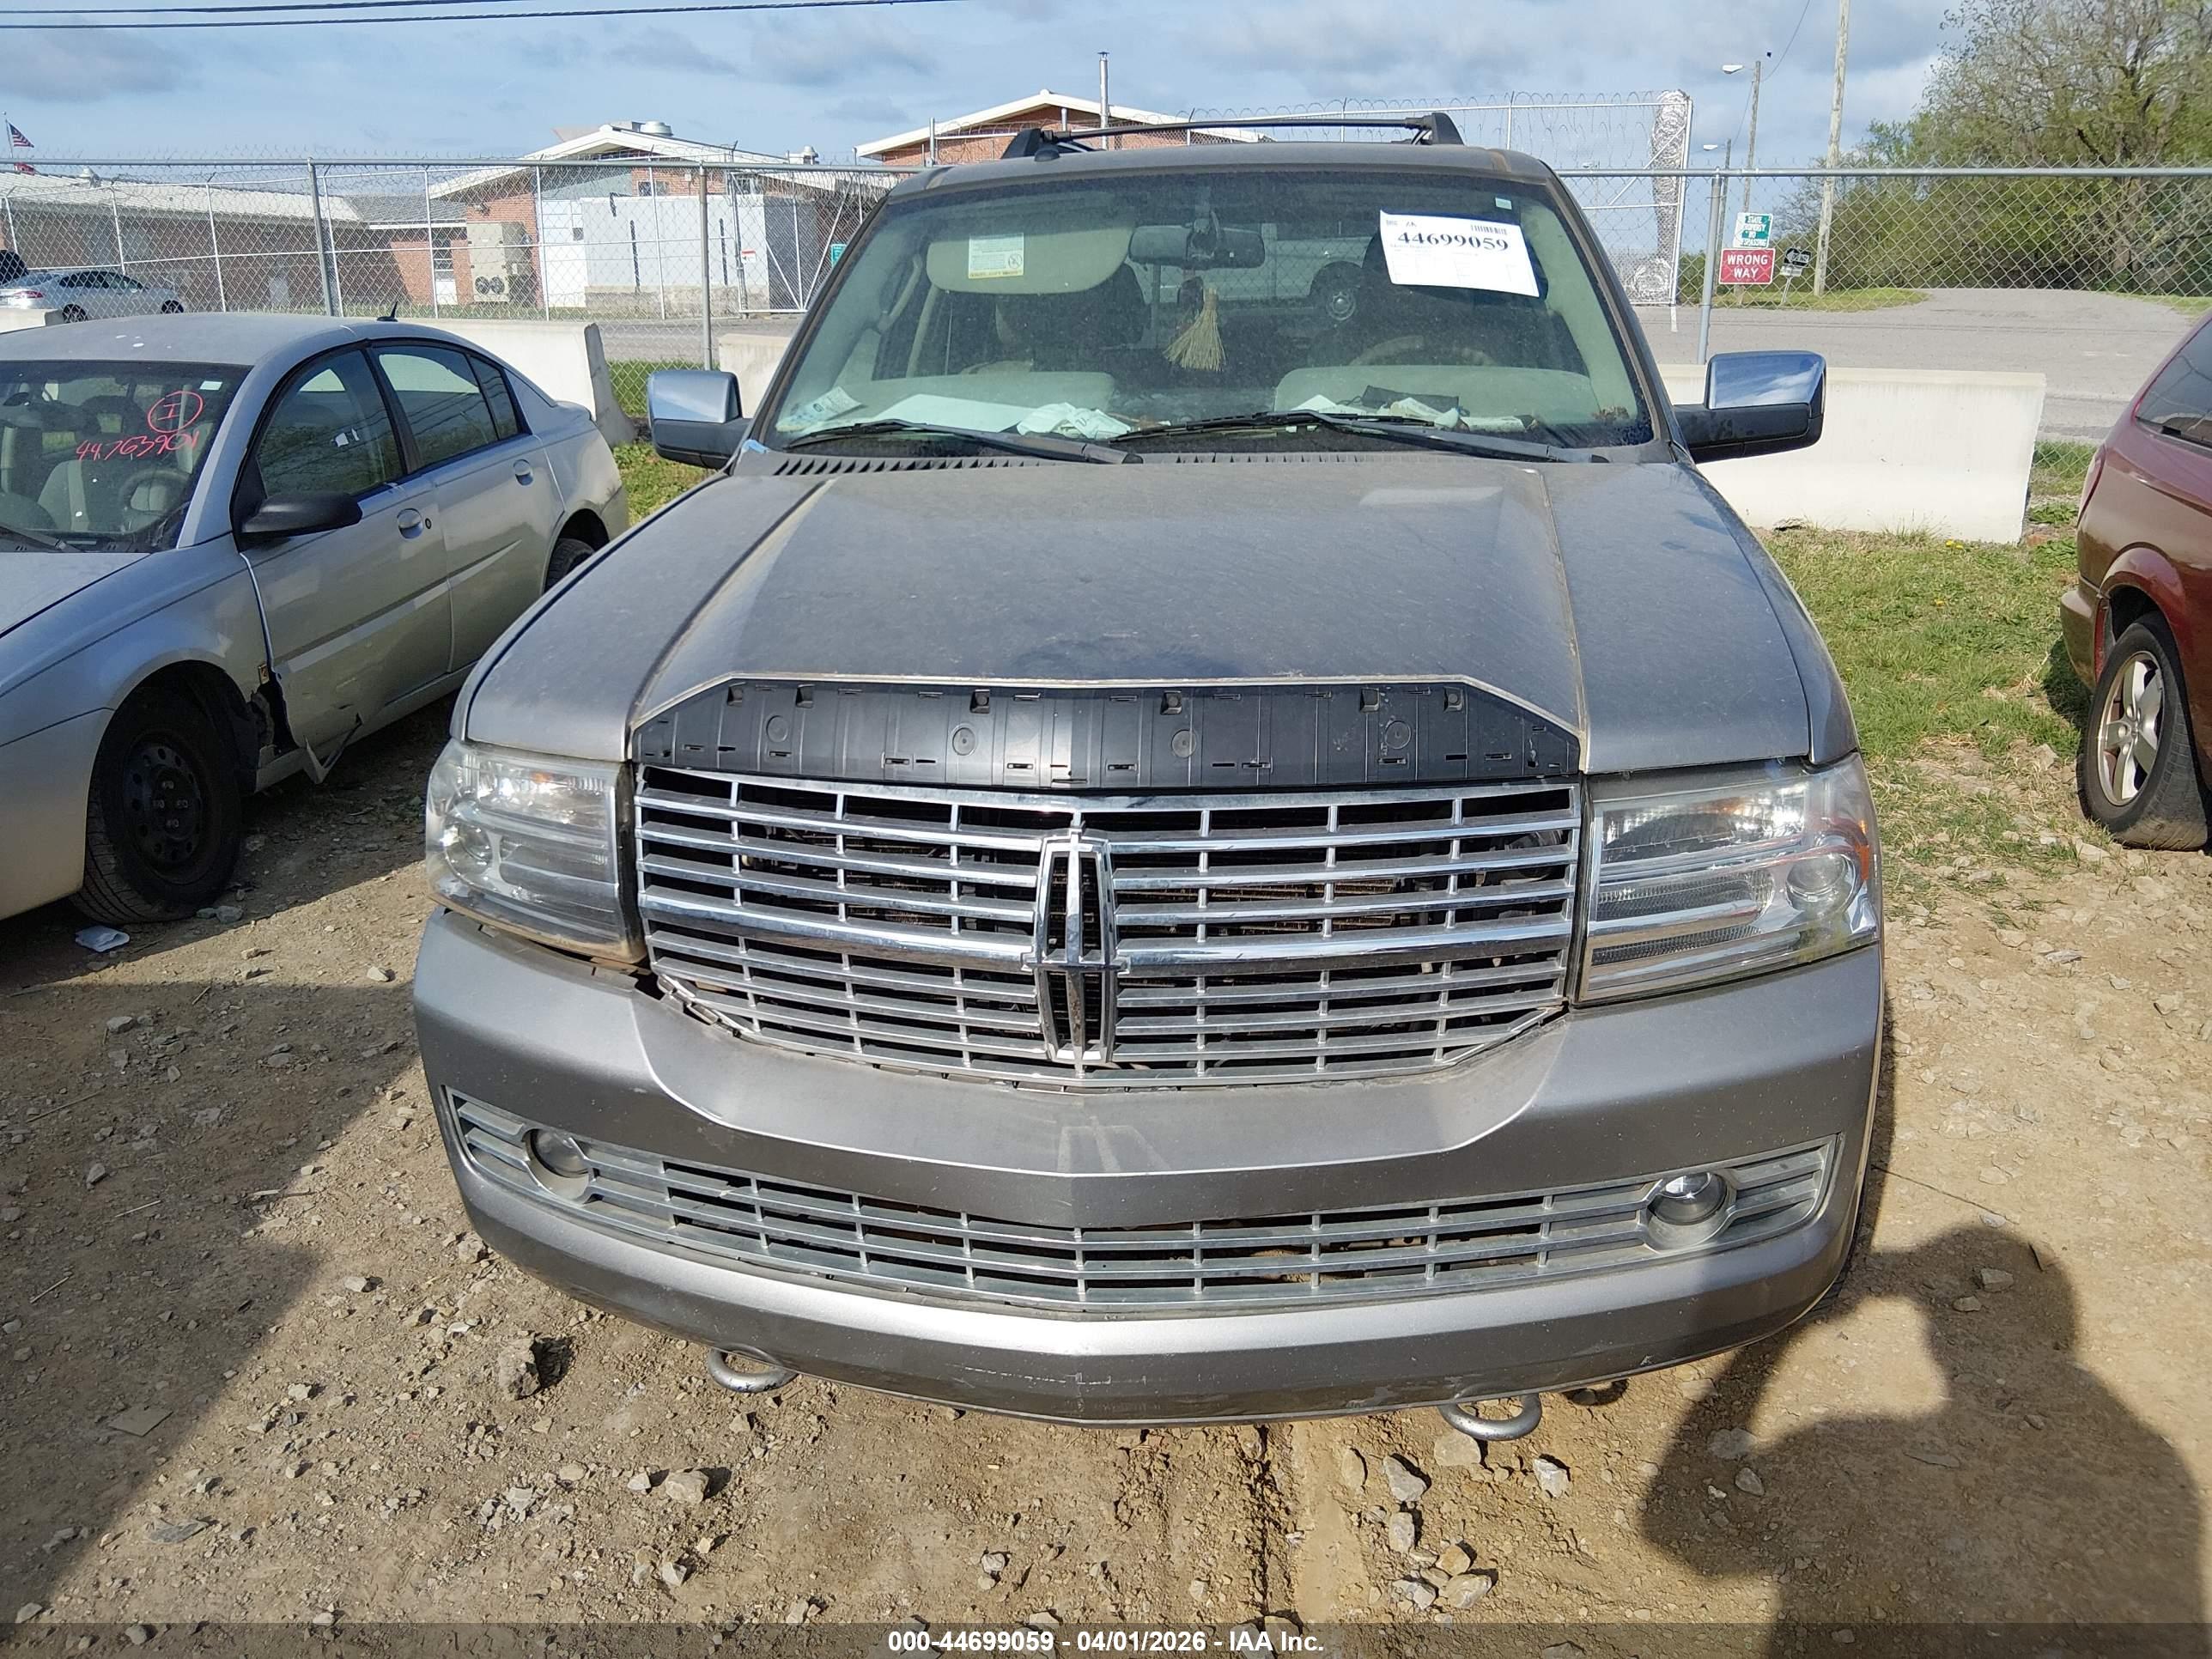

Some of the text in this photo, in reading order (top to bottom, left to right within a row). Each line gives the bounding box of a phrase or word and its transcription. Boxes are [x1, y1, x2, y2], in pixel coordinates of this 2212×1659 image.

[1398, 232, 1509, 251] 44699059
[1727, 254, 1768, 265] WRONG
[1734, 267, 1759, 278] WAY
